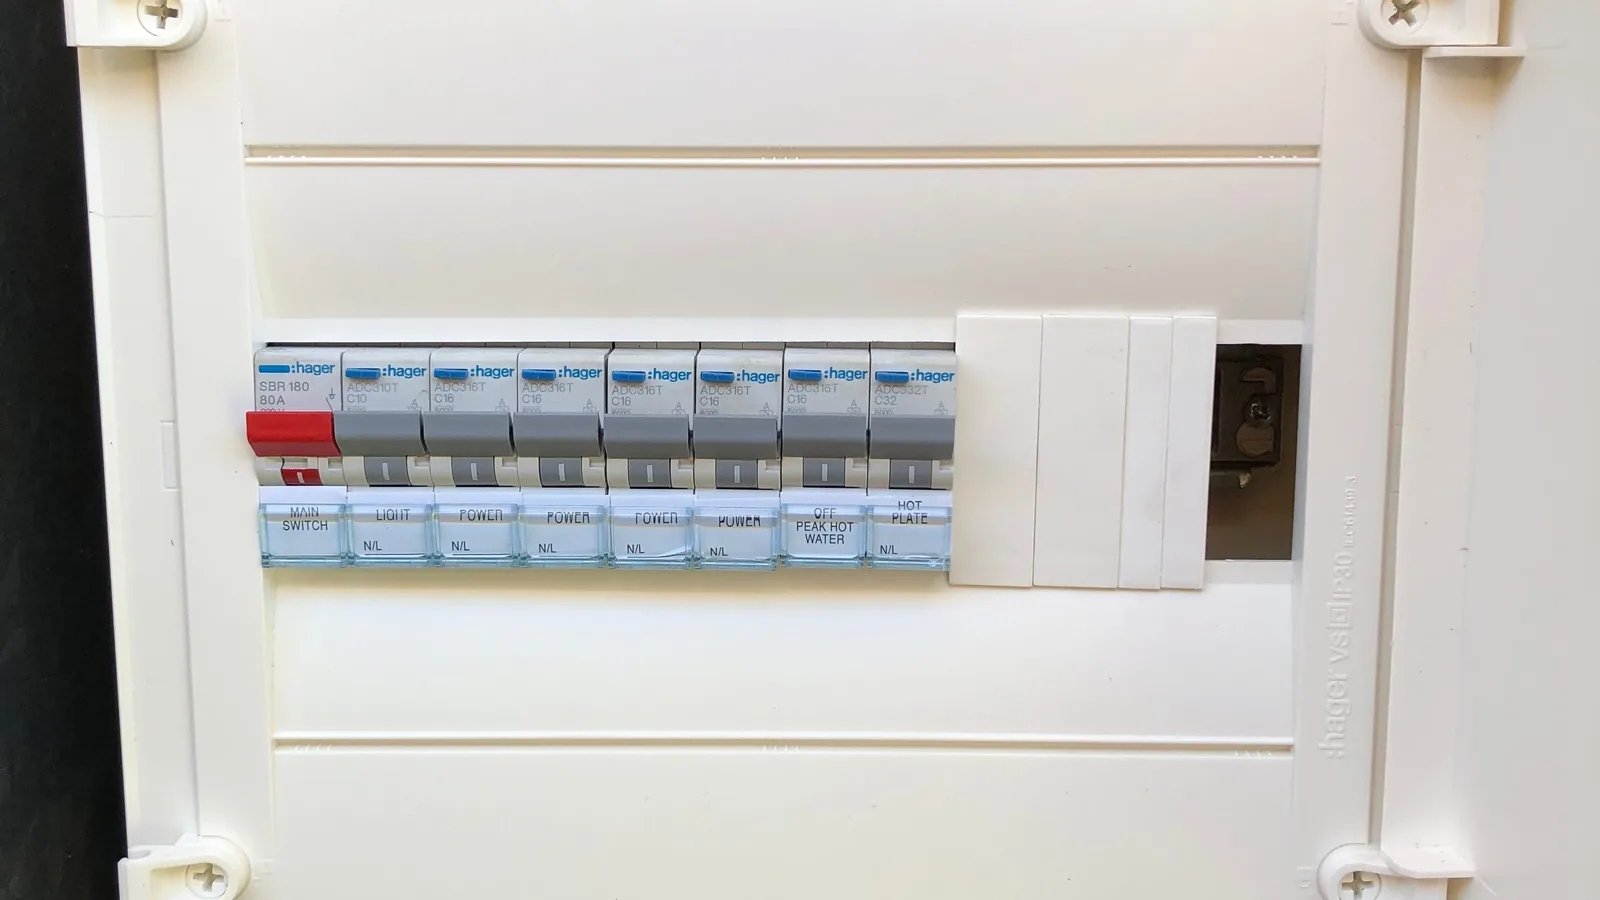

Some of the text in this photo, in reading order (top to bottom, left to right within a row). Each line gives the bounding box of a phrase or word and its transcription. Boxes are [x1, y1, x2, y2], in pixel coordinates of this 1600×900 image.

[260, 382, 309, 391] SBR 180
[347, 383, 399, 392] ADC310T
[434, 382, 486, 392] ADC316T
[522, 383, 573, 392] ADC316T
[612, 385, 662, 395] ADC316T
[700, 386, 751, 395] ADC316T
[788, 384, 839, 393] ADC316T
[875, 385, 929, 395] ADC332T
[347, 394, 367, 403] C10
[434, 394, 454, 403] C16
[522, 394, 542, 403] C16
[612, 397, 631, 406] C16
[700, 397, 719, 406] C16
[788, 395, 807, 403] C16
[875, 396, 896, 405] C32
[898, 501, 922, 510] HOT
[291, 507, 319, 517] MAIN
[814, 508, 836, 519] OFF
[547, 512, 589, 523] POWER
[892, 513, 928, 524] PLATE
[283, 521, 328, 530] SWITCH
[797, 522, 854, 532] PEAK HOT
[805, 534, 844, 544] WATER
[364, 541, 382, 551] N/L
[452, 541, 470, 551] N/L
[539, 544, 556, 553] N/L
[627, 544, 644, 554] N/L
[880, 545, 897, 554] N/L
[710, 548, 728, 556] N/L
